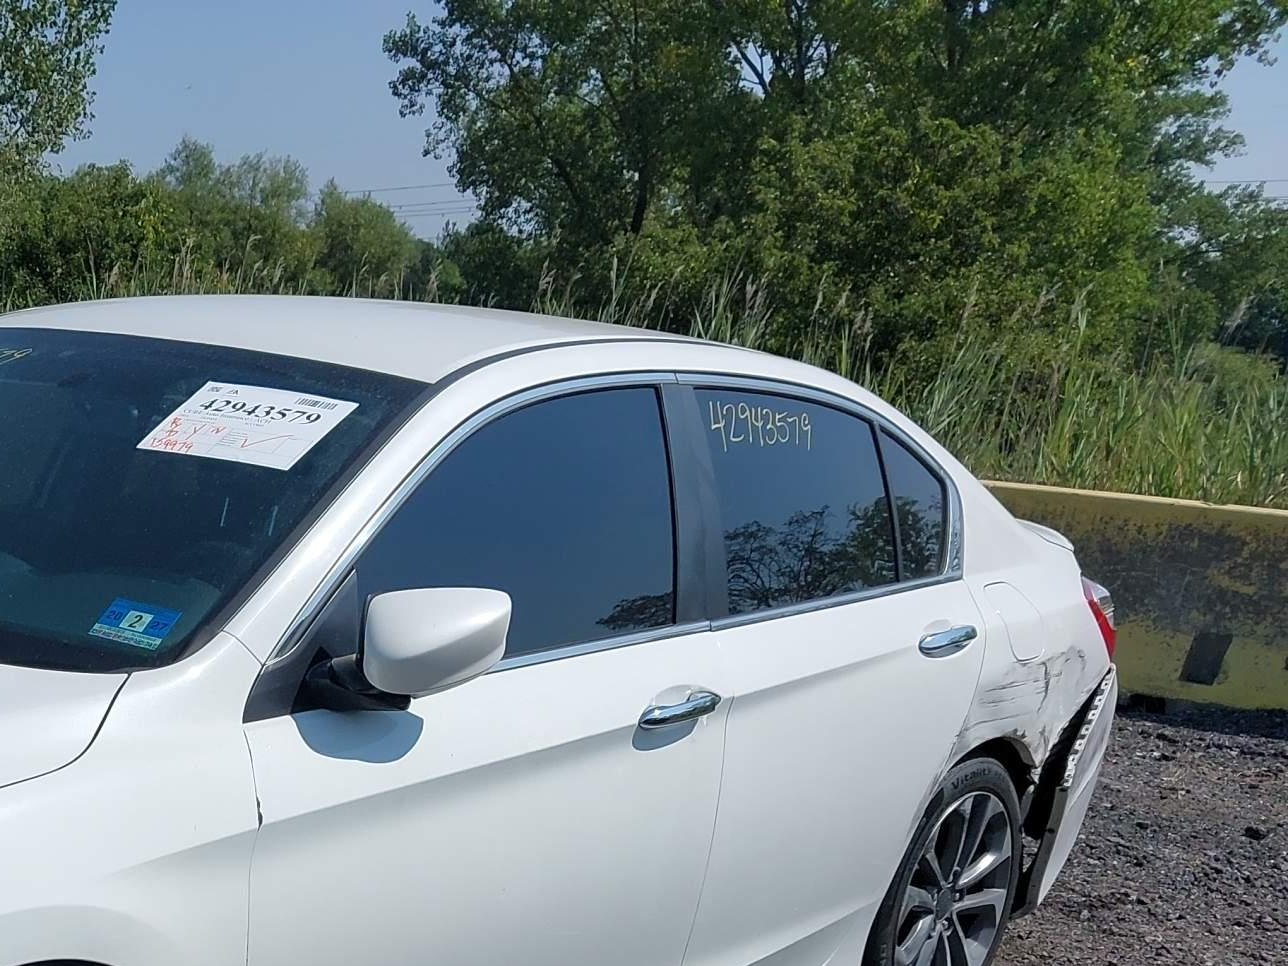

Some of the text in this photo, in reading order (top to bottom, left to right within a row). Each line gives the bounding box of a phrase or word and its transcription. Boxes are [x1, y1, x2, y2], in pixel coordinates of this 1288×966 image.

[199, 397, 322, 425] 42943579
[708, 400, 813, 453] 42943579
[129, 615, 143, 628] 2
